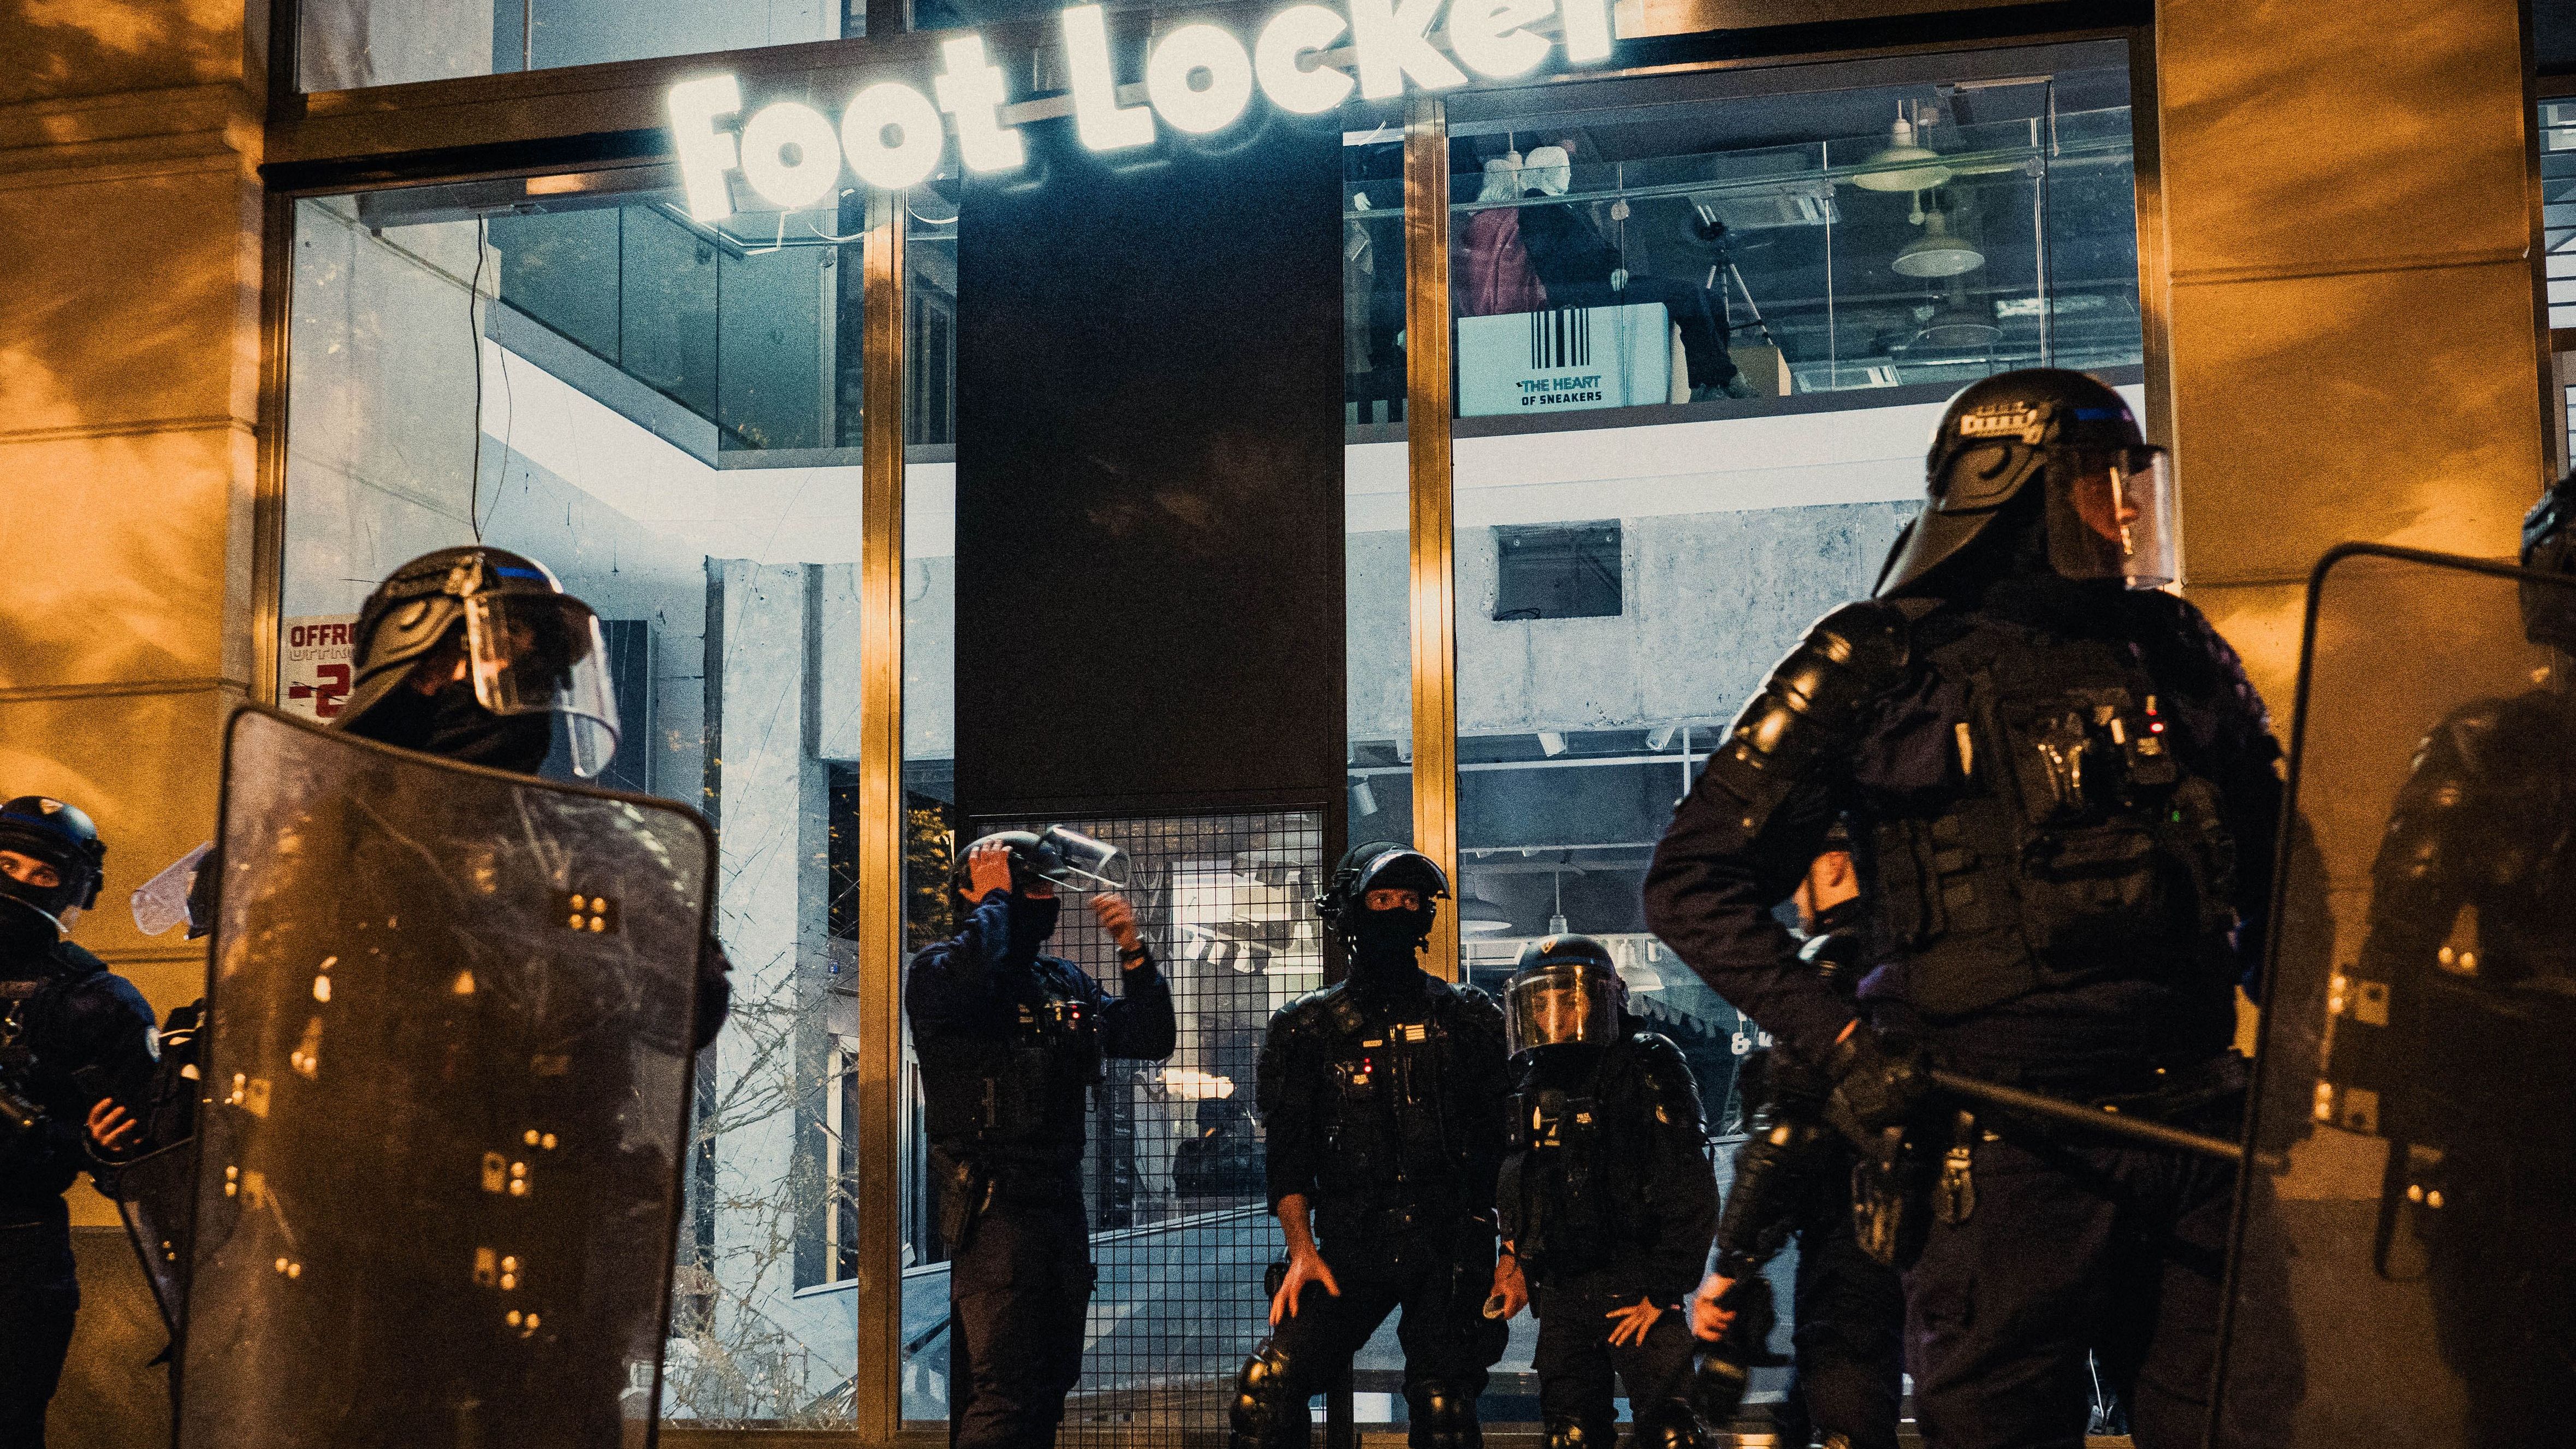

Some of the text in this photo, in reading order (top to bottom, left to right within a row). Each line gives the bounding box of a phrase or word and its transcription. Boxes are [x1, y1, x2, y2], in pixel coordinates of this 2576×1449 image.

[668, 34, 1025, 222] Foot
[1521, 375, 1602, 393] THE HEART
[1521, 391, 1602, 406] OF SNEAKERS
